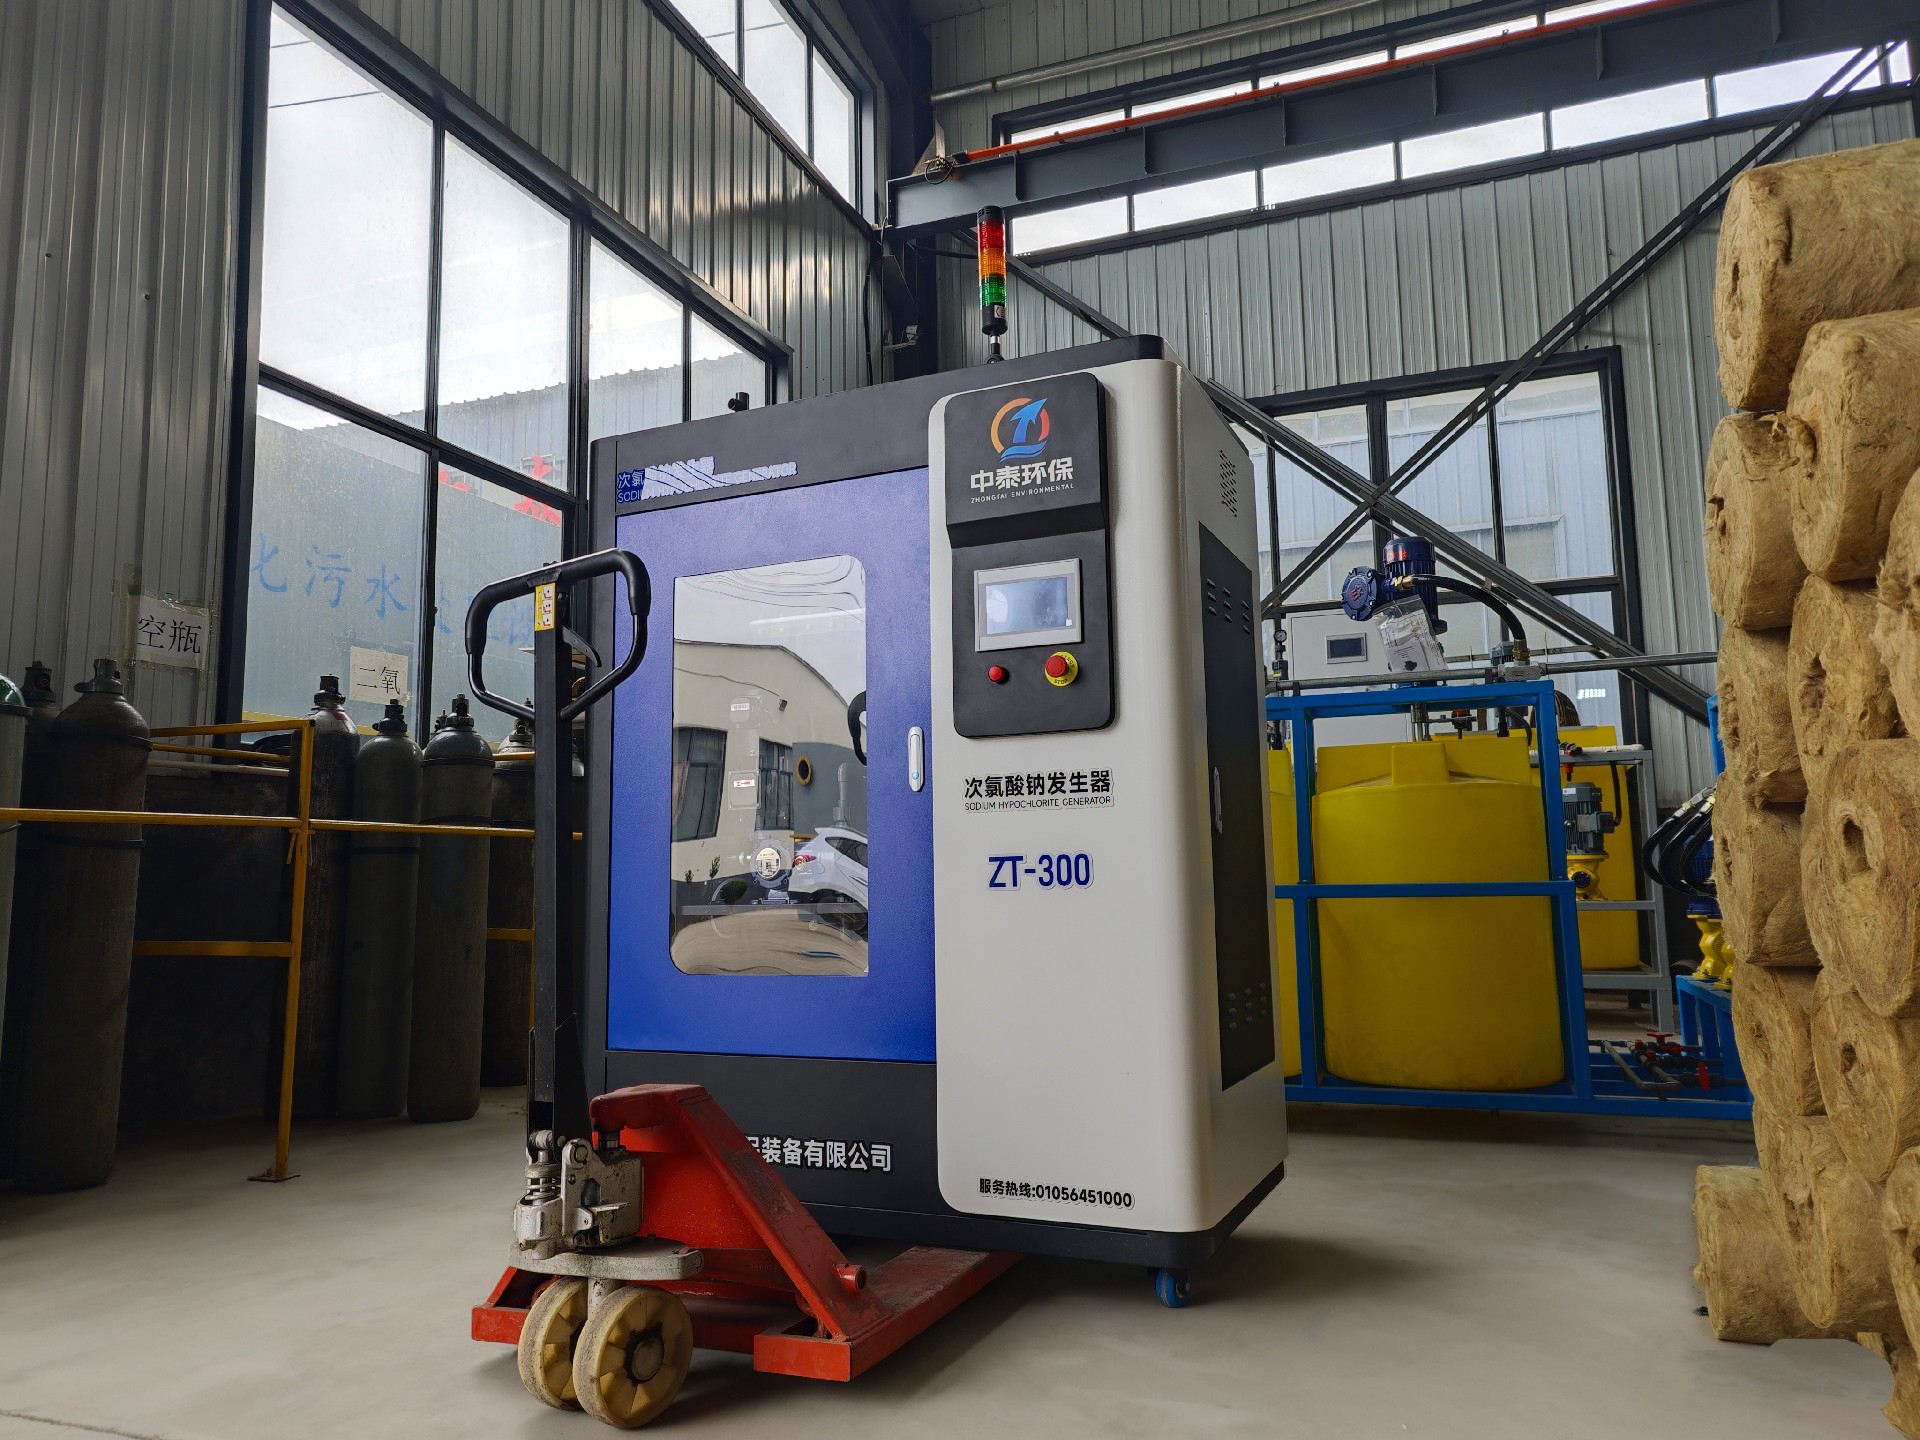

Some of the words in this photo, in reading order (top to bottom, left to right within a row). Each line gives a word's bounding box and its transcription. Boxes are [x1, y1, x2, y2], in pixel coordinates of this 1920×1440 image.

[970, 456, 1074, 493] 中泰环保
[1011, 483, 1074, 498] ENVIRONMENTAL
[137, 615, 202, 654] 空瓶
[356, 666, 401, 695] 二氧
[964, 769, 1111, 799] 次氯酸钠发生器
[964, 801, 996, 811] SODIUM
[998, 798, 1060, 809] HYPOCHLORITE
[1062, 795, 1111, 806] GENERATOR
[988, 853, 1091, 888] ZT-300
